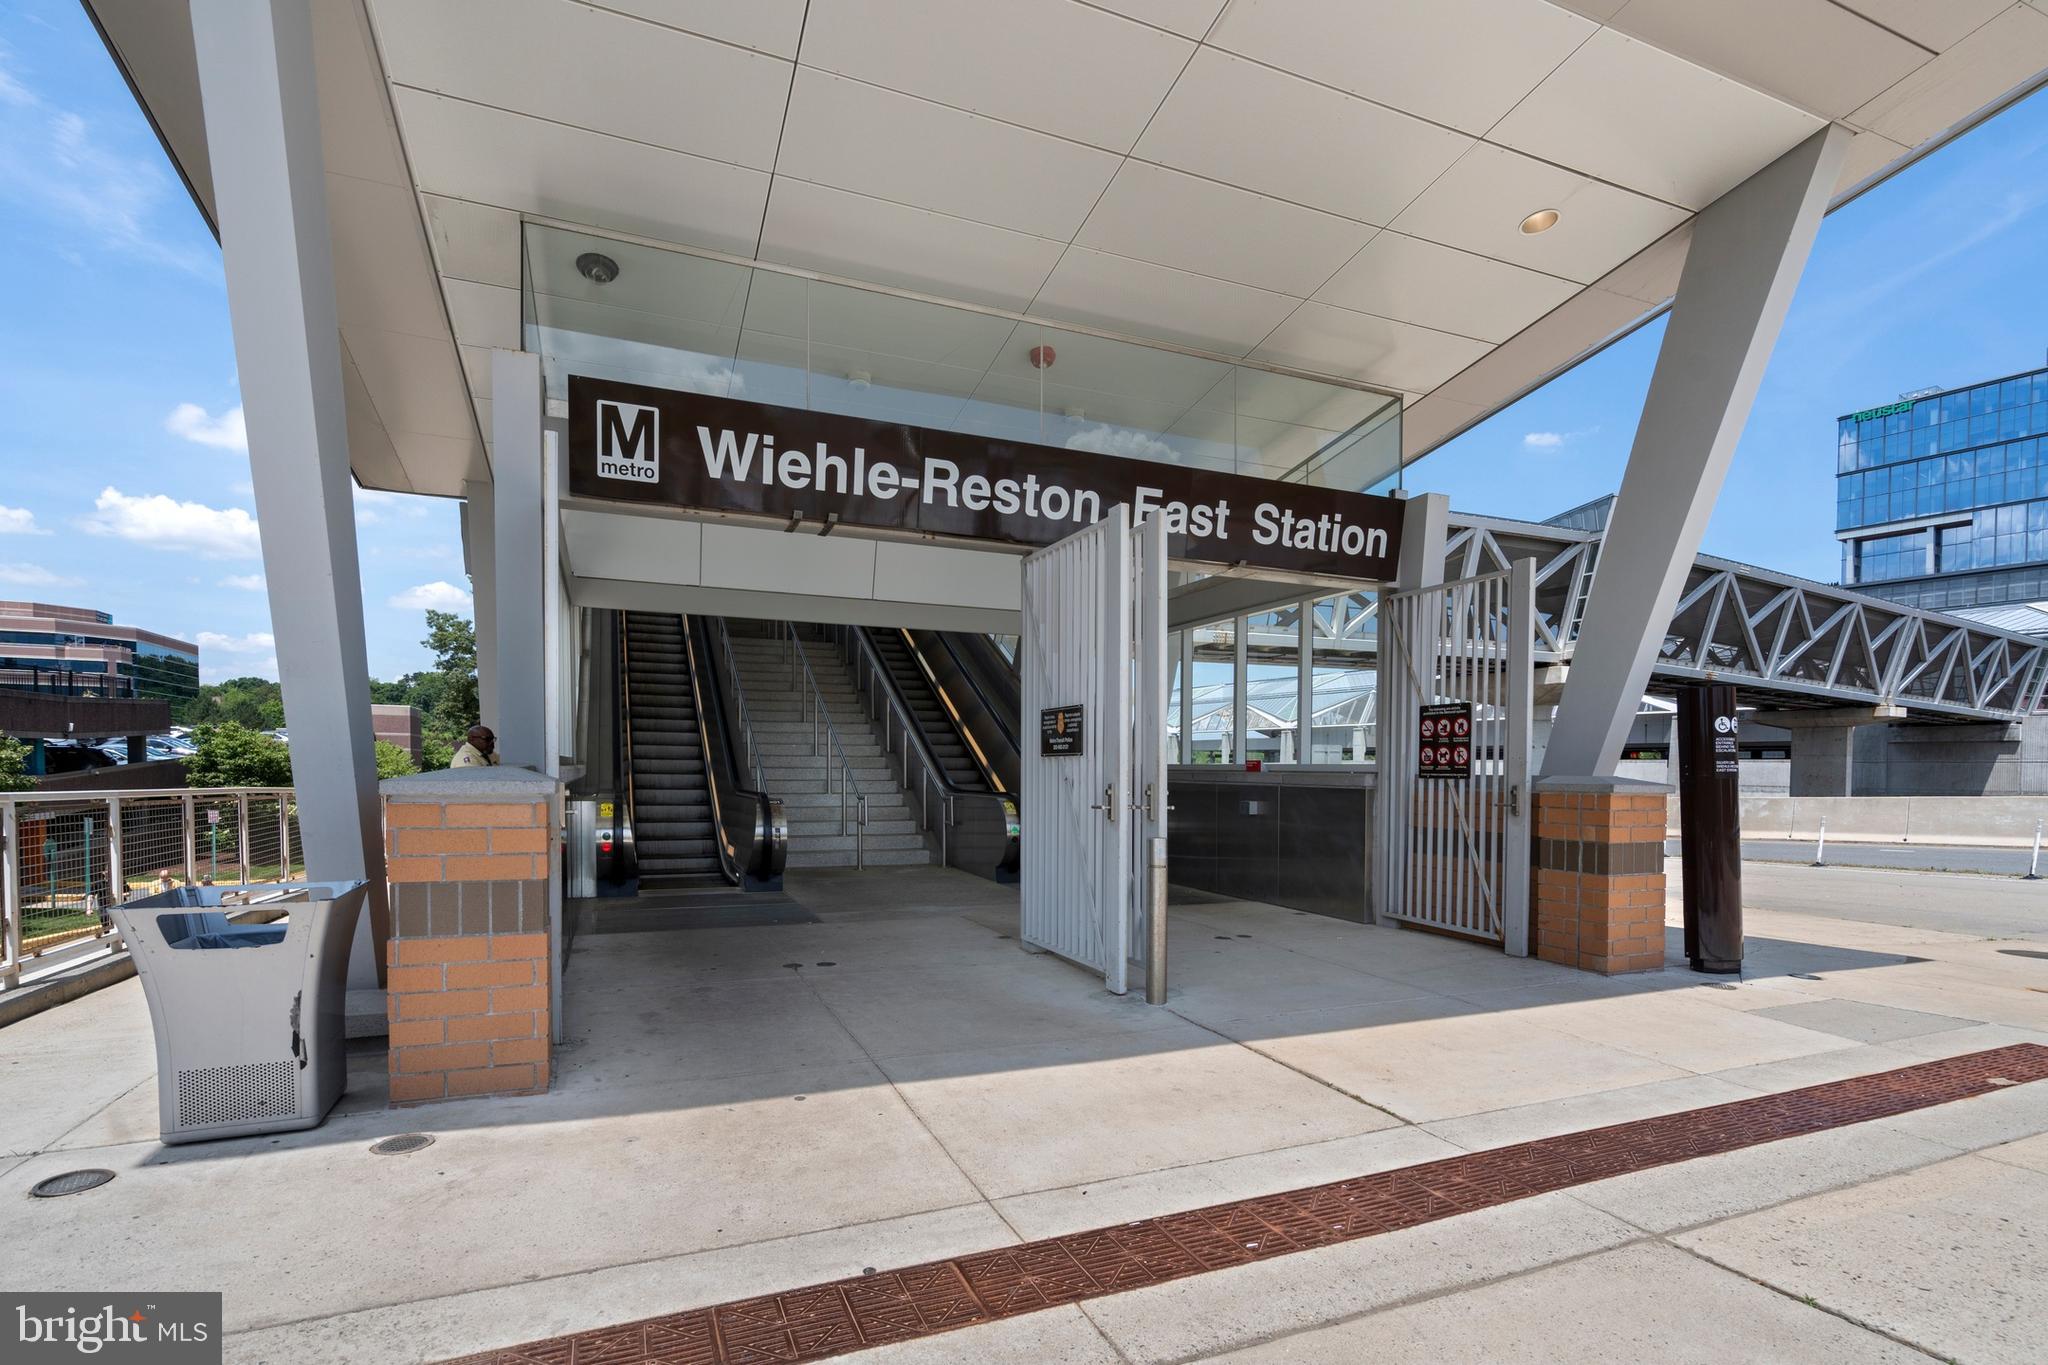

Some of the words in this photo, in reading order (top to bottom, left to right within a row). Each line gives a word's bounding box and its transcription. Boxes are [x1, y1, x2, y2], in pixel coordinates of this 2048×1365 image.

[1852, 400, 1916, 422] neustar
[601, 403, 656, 462] M
[600, 461, 656, 480] metro
[696, 425, 1100, 524] Wiehle-Reston
[1134, 486, 1230, 540] East
[1252, 503, 1388, 558] Station
